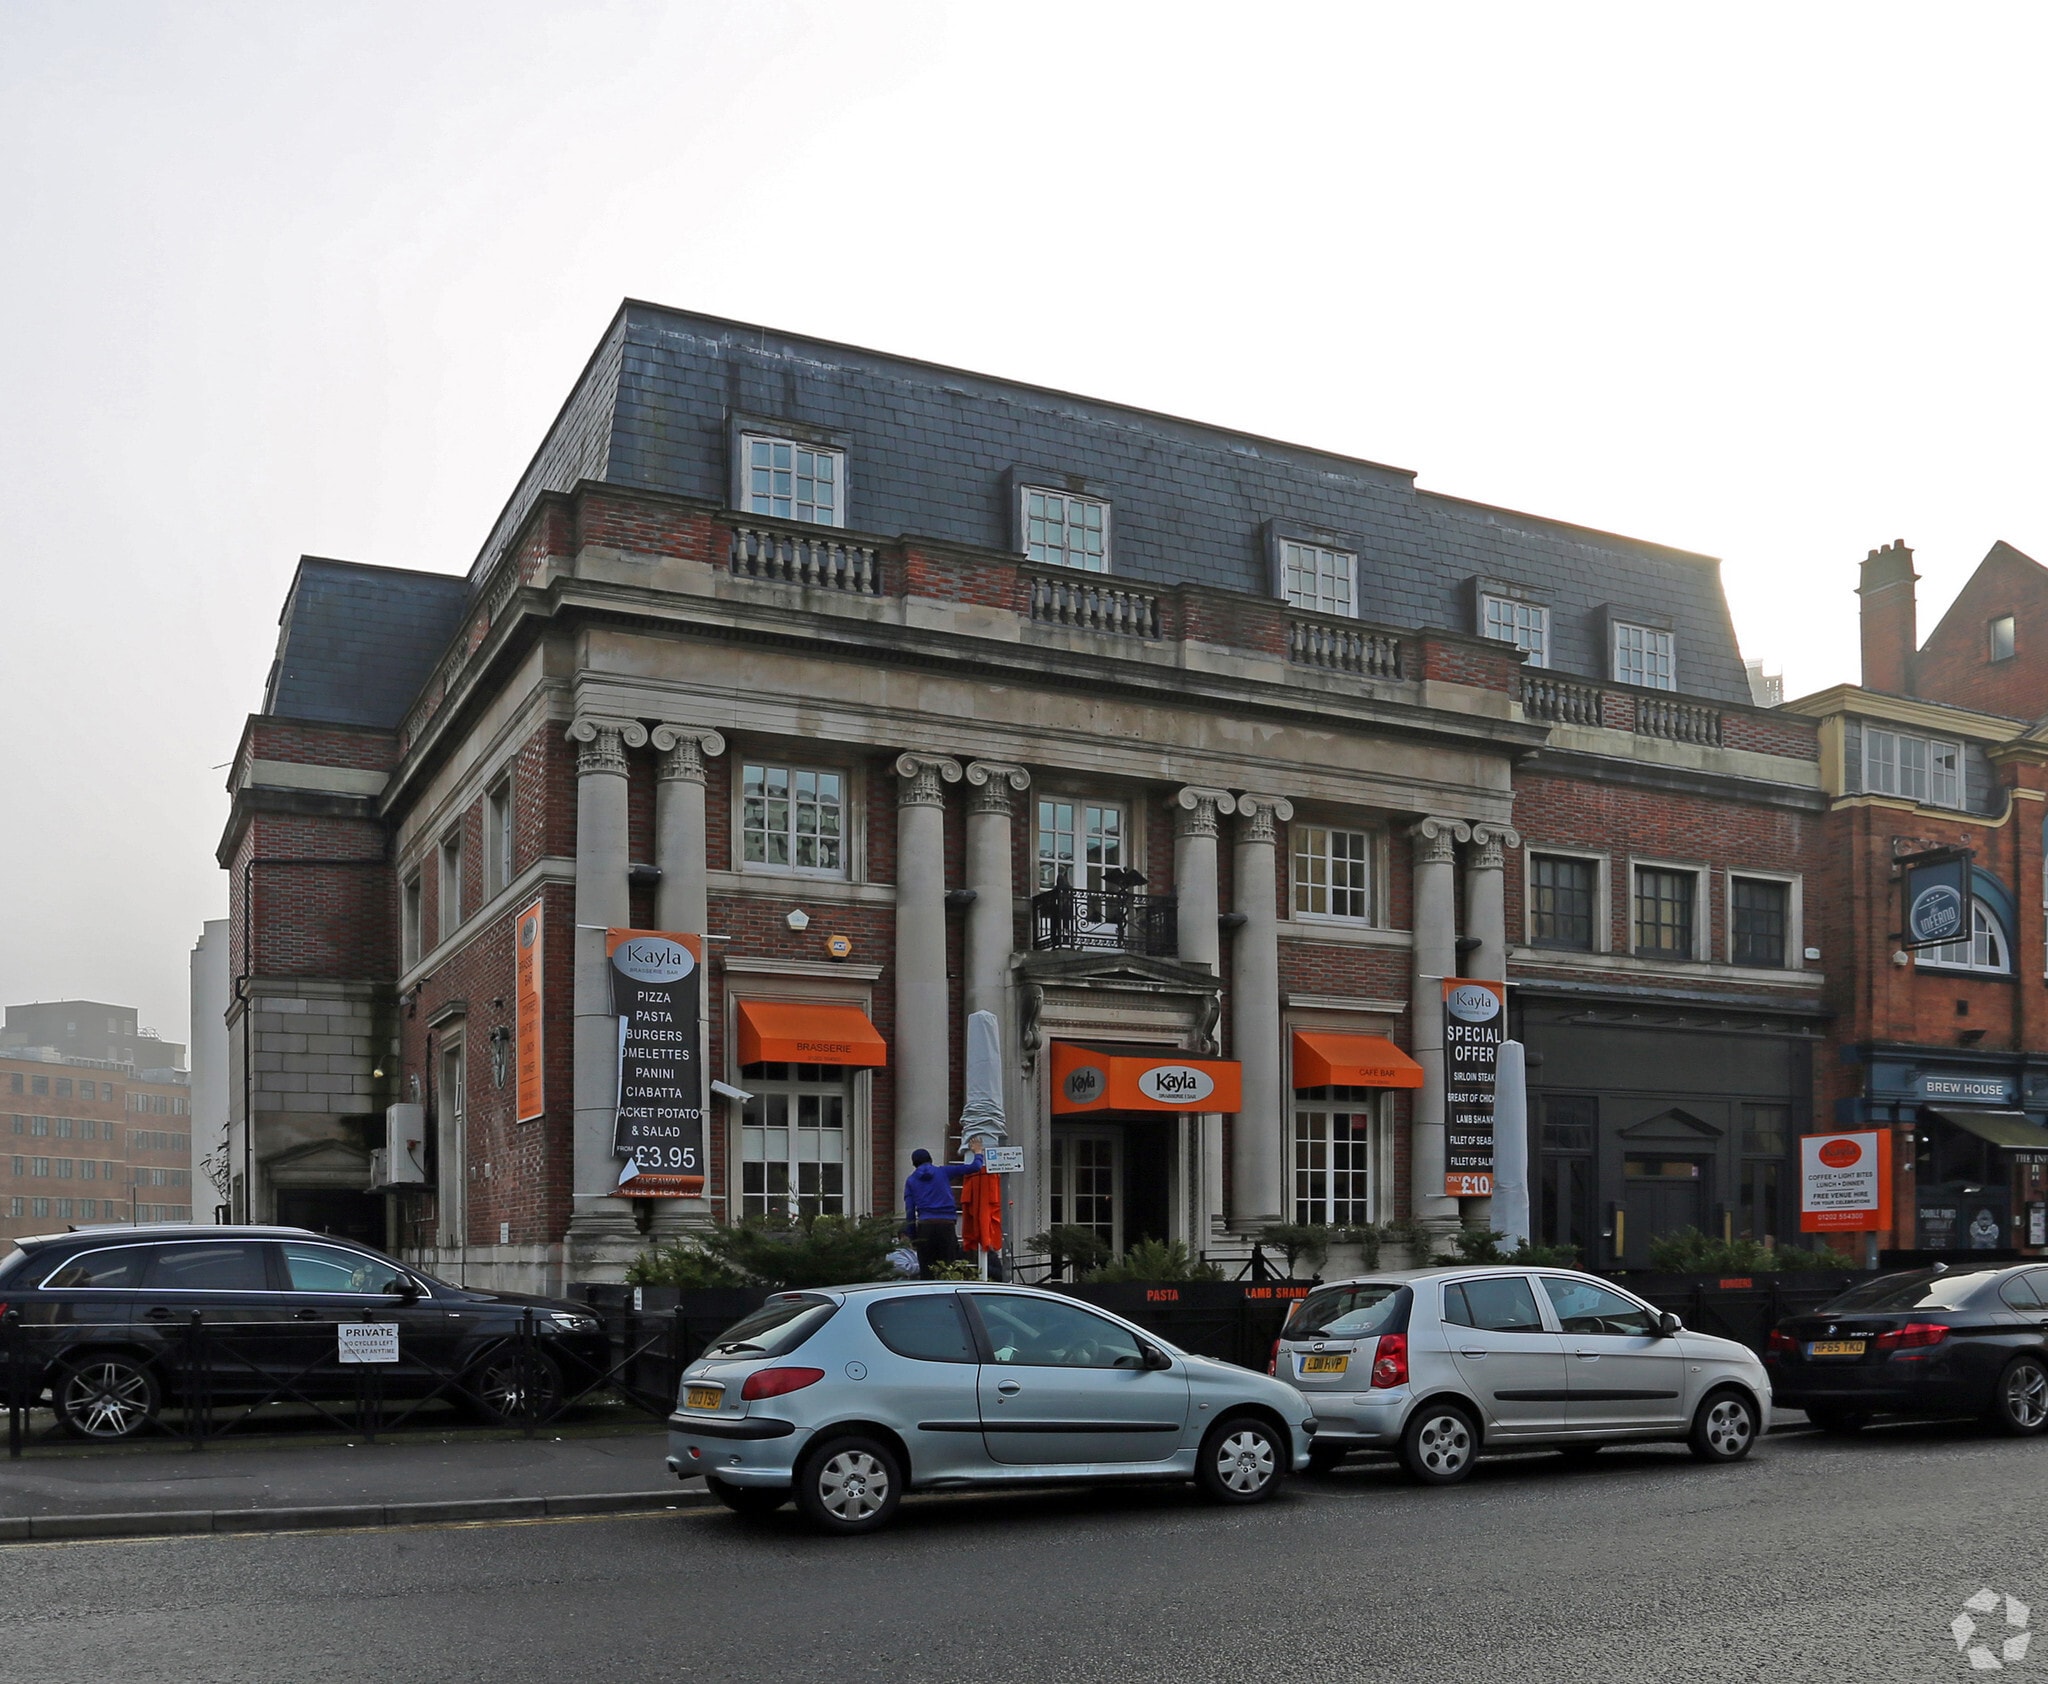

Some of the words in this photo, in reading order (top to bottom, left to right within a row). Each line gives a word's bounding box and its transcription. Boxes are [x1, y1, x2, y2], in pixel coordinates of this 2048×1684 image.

[1920, 906, 1956, 932] INFERNO
[628, 945, 681, 967] Kayla
[629, 967, 662, 975] BRASSERIE
[637, 991, 671, 1003] PIZZA
[1456, 992, 1491, 1009] Kayla
[636, 1010, 673, 1022] PASTA
[626, 1028, 683, 1041] BURGERS
[1447, 1026, 1501, 1043] SPECIAL
[796, 1042, 852, 1053] BRASSERIE
[1455, 1046, 1494, 1062] OFFER
[635, 1067, 674, 1079] PANINI
[1380, 1069, 1395, 1077] BAR
[1453, 1071, 1477, 1081] SIRLOIN
[1072, 1070, 1095, 1093] Kayla
[1156, 1071, 1197, 1092] Kayla
[626, 1086, 682, 1098] CIABATTA
[1926, 1081, 1960, 1093] BREW
[1964, 1084, 2004, 1095] HOUSE
[1447, 1092, 1469, 1102] BREAST
[1469, 1093, 1478, 1102] OF
[618, 1107, 655, 1118] ACKET
[657, 1108, 699, 1119] POTATO
[1456, 1114, 1472, 1123] LAMB
[631, 1125, 639, 1136] &
[642, 1126, 680, 1137] SALAD
[1450, 1135, 1467, 1145] FILLET
[1467, 1136, 1475, 1145] OF
[635, 1145, 695, 1169] £3.95
[1450, 1156, 1468, 1166] FILLET
[1469, 1157, 1477, 1166] OF
[2015, 1153, 2031, 1163] THE
[635, 1177, 682, 1185] TAKEAWAY
[1808, 1173, 1832, 1181] COFFEE
[1146, 1289, 1179, 1301] PASTA
[1245, 1288, 1272, 1299] LAMB
[1275, 1287, 1308, 1298] SHANK
[346, 1328, 393, 1337] PRIVATE
